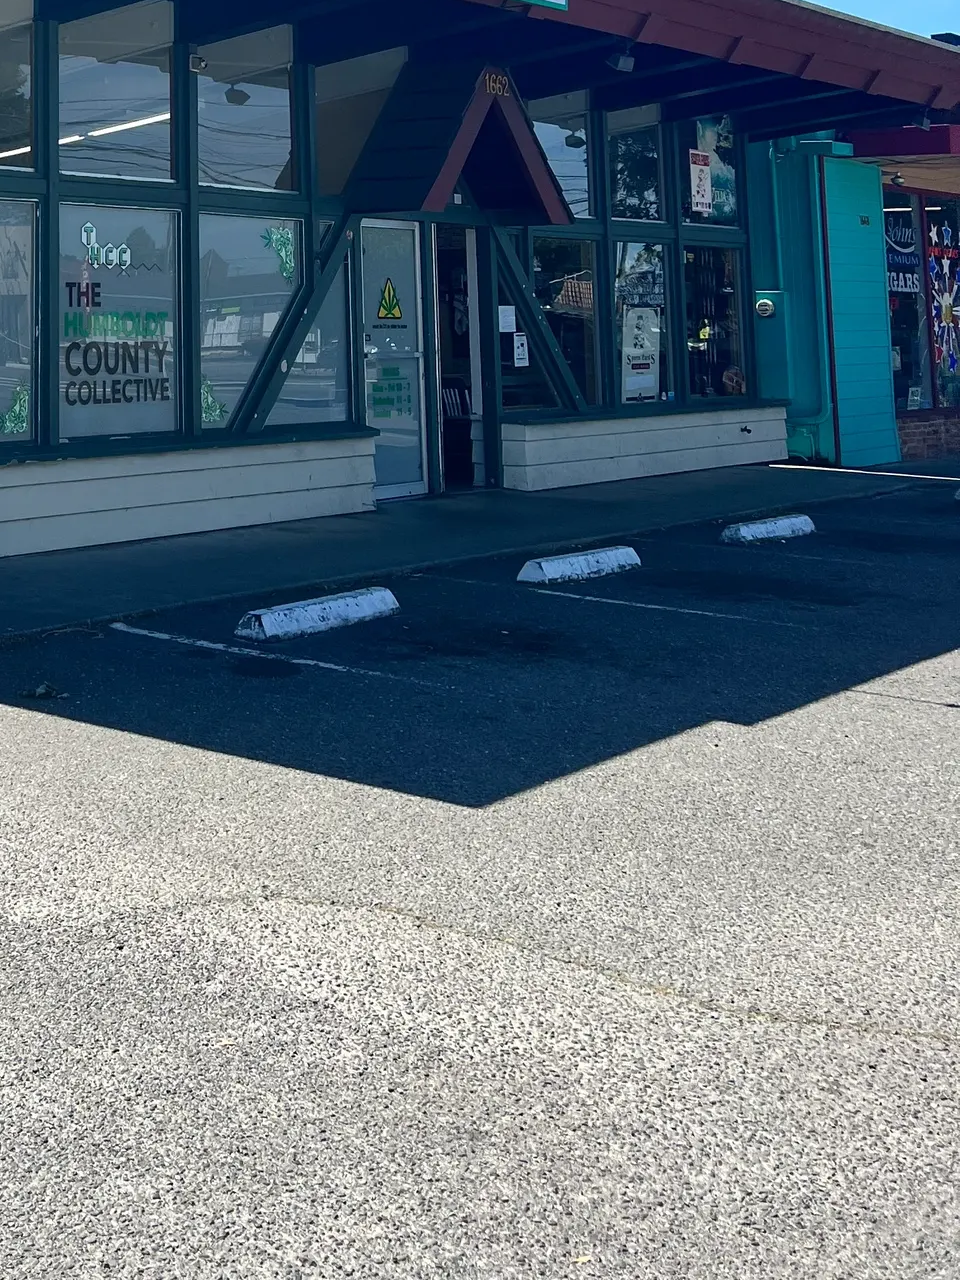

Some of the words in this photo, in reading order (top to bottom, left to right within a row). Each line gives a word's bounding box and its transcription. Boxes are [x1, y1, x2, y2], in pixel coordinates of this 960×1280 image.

[485, 72, 510, 97] 1662
[888, 253, 919, 265] EMIUM
[65, 281, 102, 308] THE
[887, 272, 920, 293] IGARS
[63, 311, 168, 337] HUMBOLDT
[65, 341, 169, 377] COUNTY
[65, 377, 170, 407] COLLECTIVE
